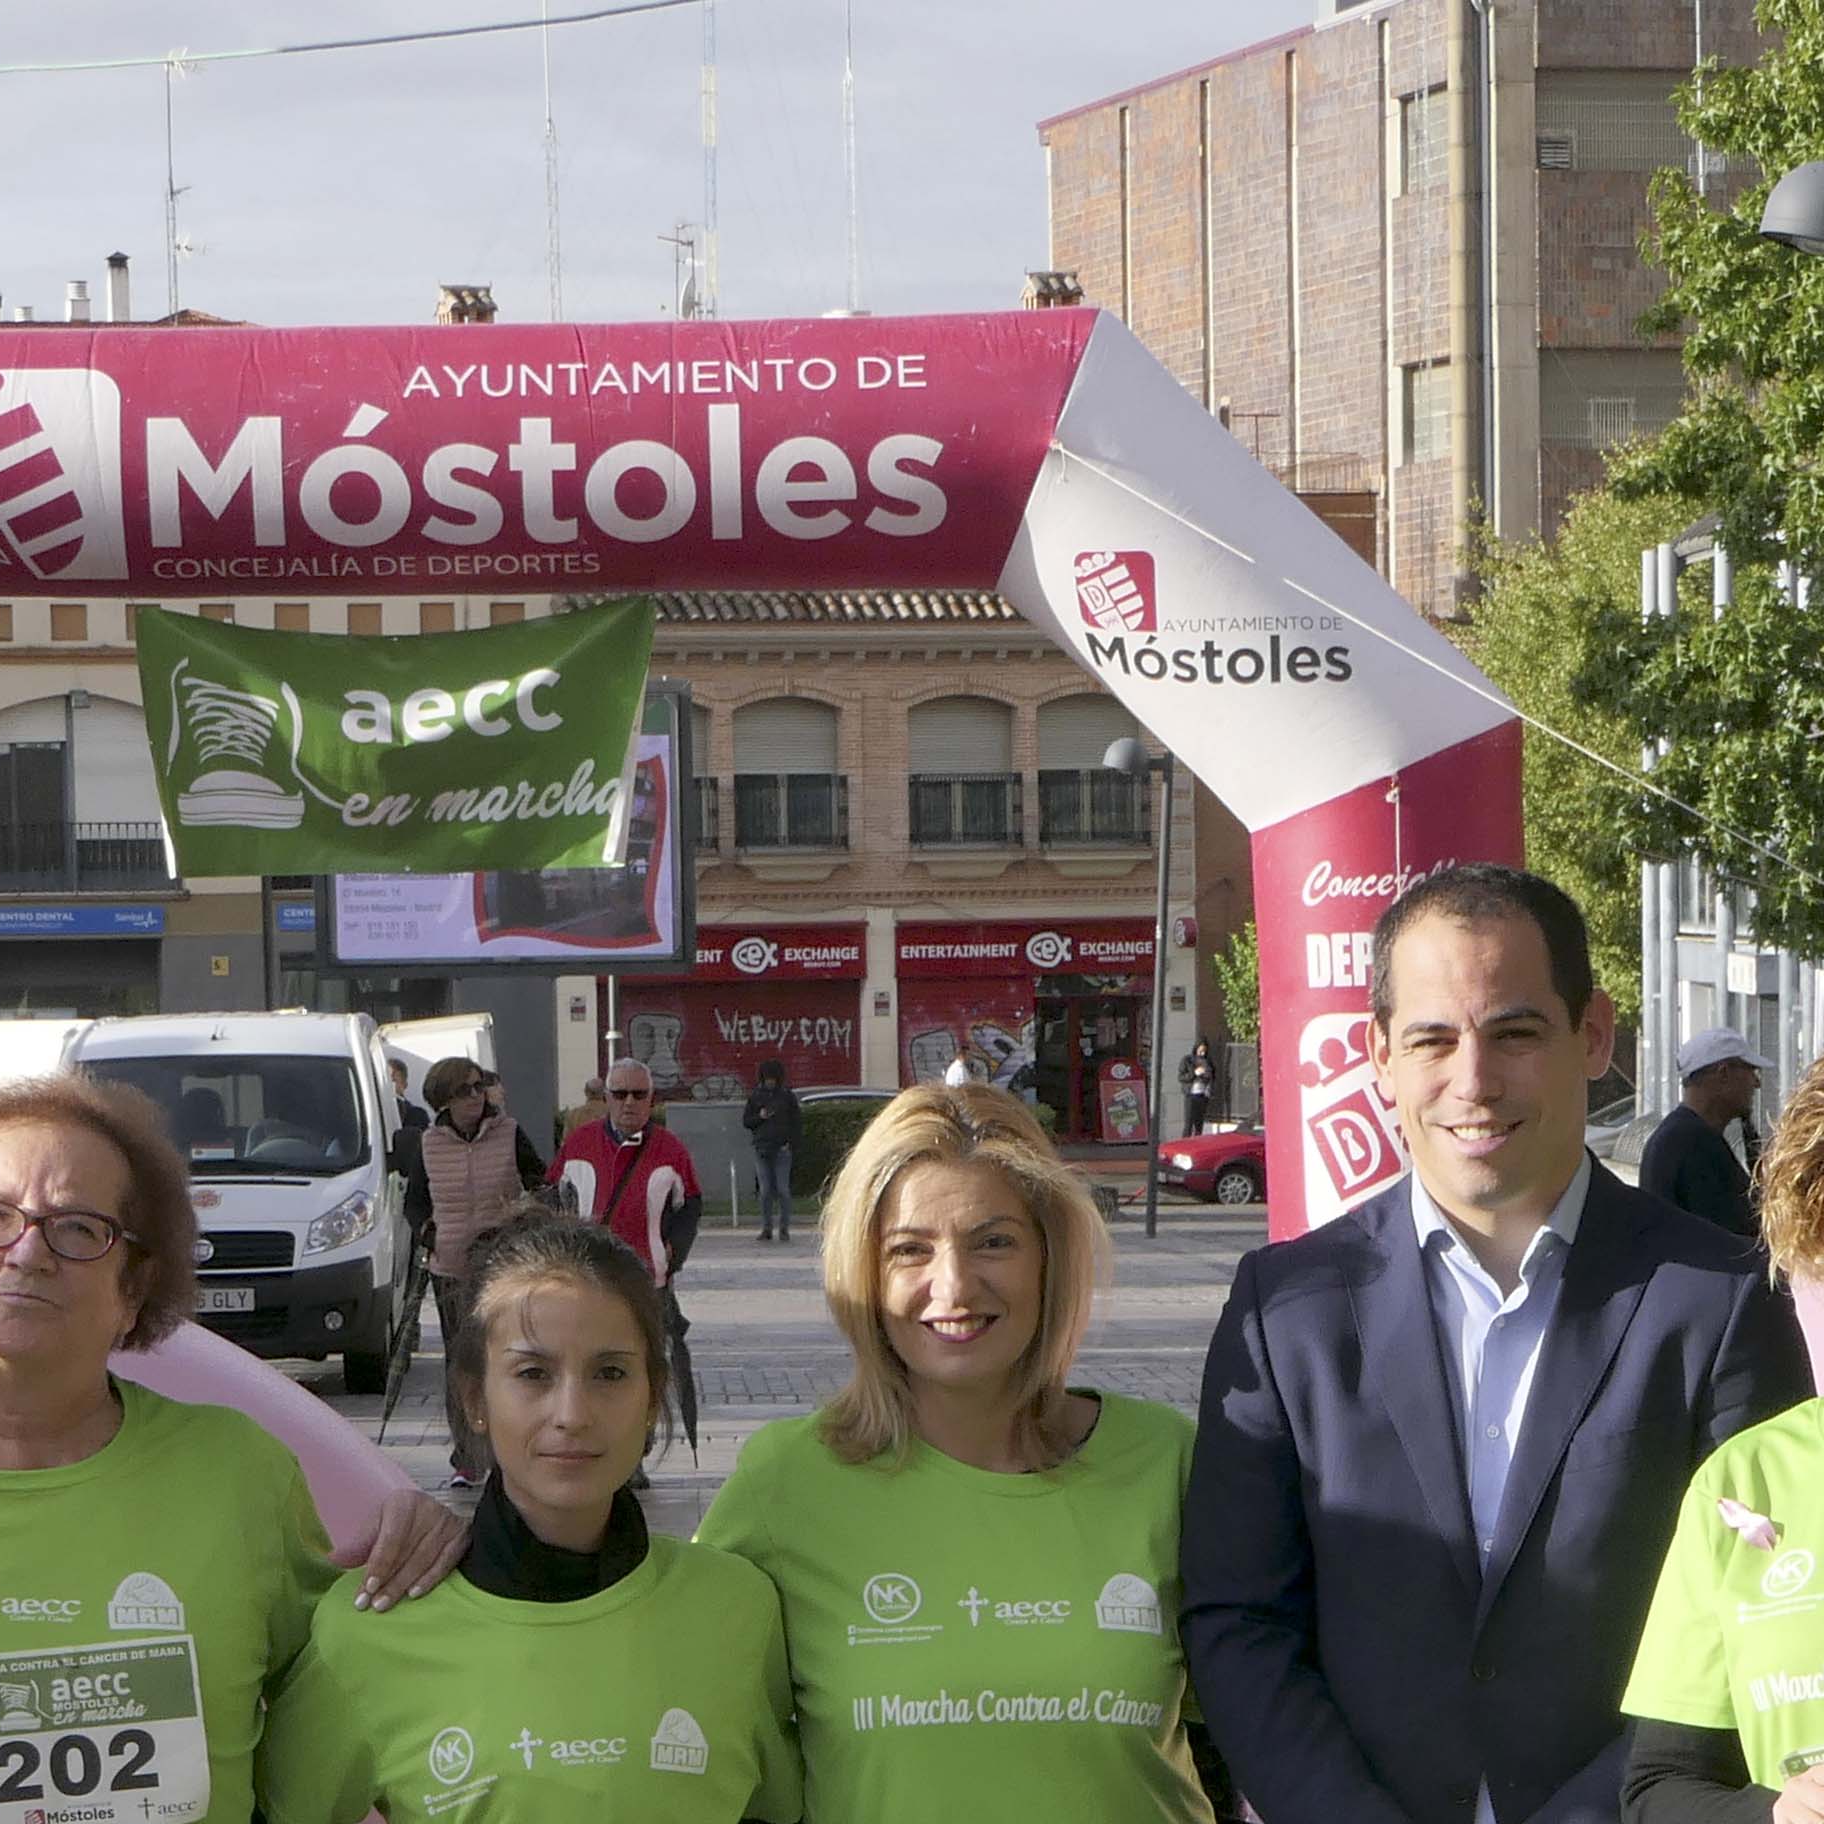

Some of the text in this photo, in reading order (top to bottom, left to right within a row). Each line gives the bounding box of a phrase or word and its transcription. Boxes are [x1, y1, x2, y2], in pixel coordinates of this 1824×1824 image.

[403, 354, 928, 399] AYUNTAMIENTO DE
[145, 402, 949, 549] Móstoles
[153, 552, 601, 580] CONCEJALÍA DE DEPORTES
[1162, 614, 1344, 633] AYUNTAMIENTO DE
[1084, 631, 1354, 685] Móstoles
[340, 668, 564, 745] aecc
[340, 757, 625, 828] en marcha
[36, 911, 75, 922] DENTAL
[784, 946, 860, 962] EXCHANGE
[900, 943, 1018, 960] ENTERTAINMENT
[1079, 940, 1153, 956] EXCHANGE
[212, 1291, 248, 1309] GLY
[1, 1596, 82, 1618] aecc
[993, 1599, 1073, 1621] aecc
[9, 1659, 59, 1674] CONTRA
[130, 1648, 147, 1661] DE
[148, 1645, 186, 1660] MAMA
[50, 1671, 132, 1702] aecc
[81, 1698, 148, 1724] marcha
[852, 1687, 1164, 1731] III Marcha Contra el Cáncer
[549, 1734, 628, 1759] aecc
[657, 1745, 704, 1768] MRM
